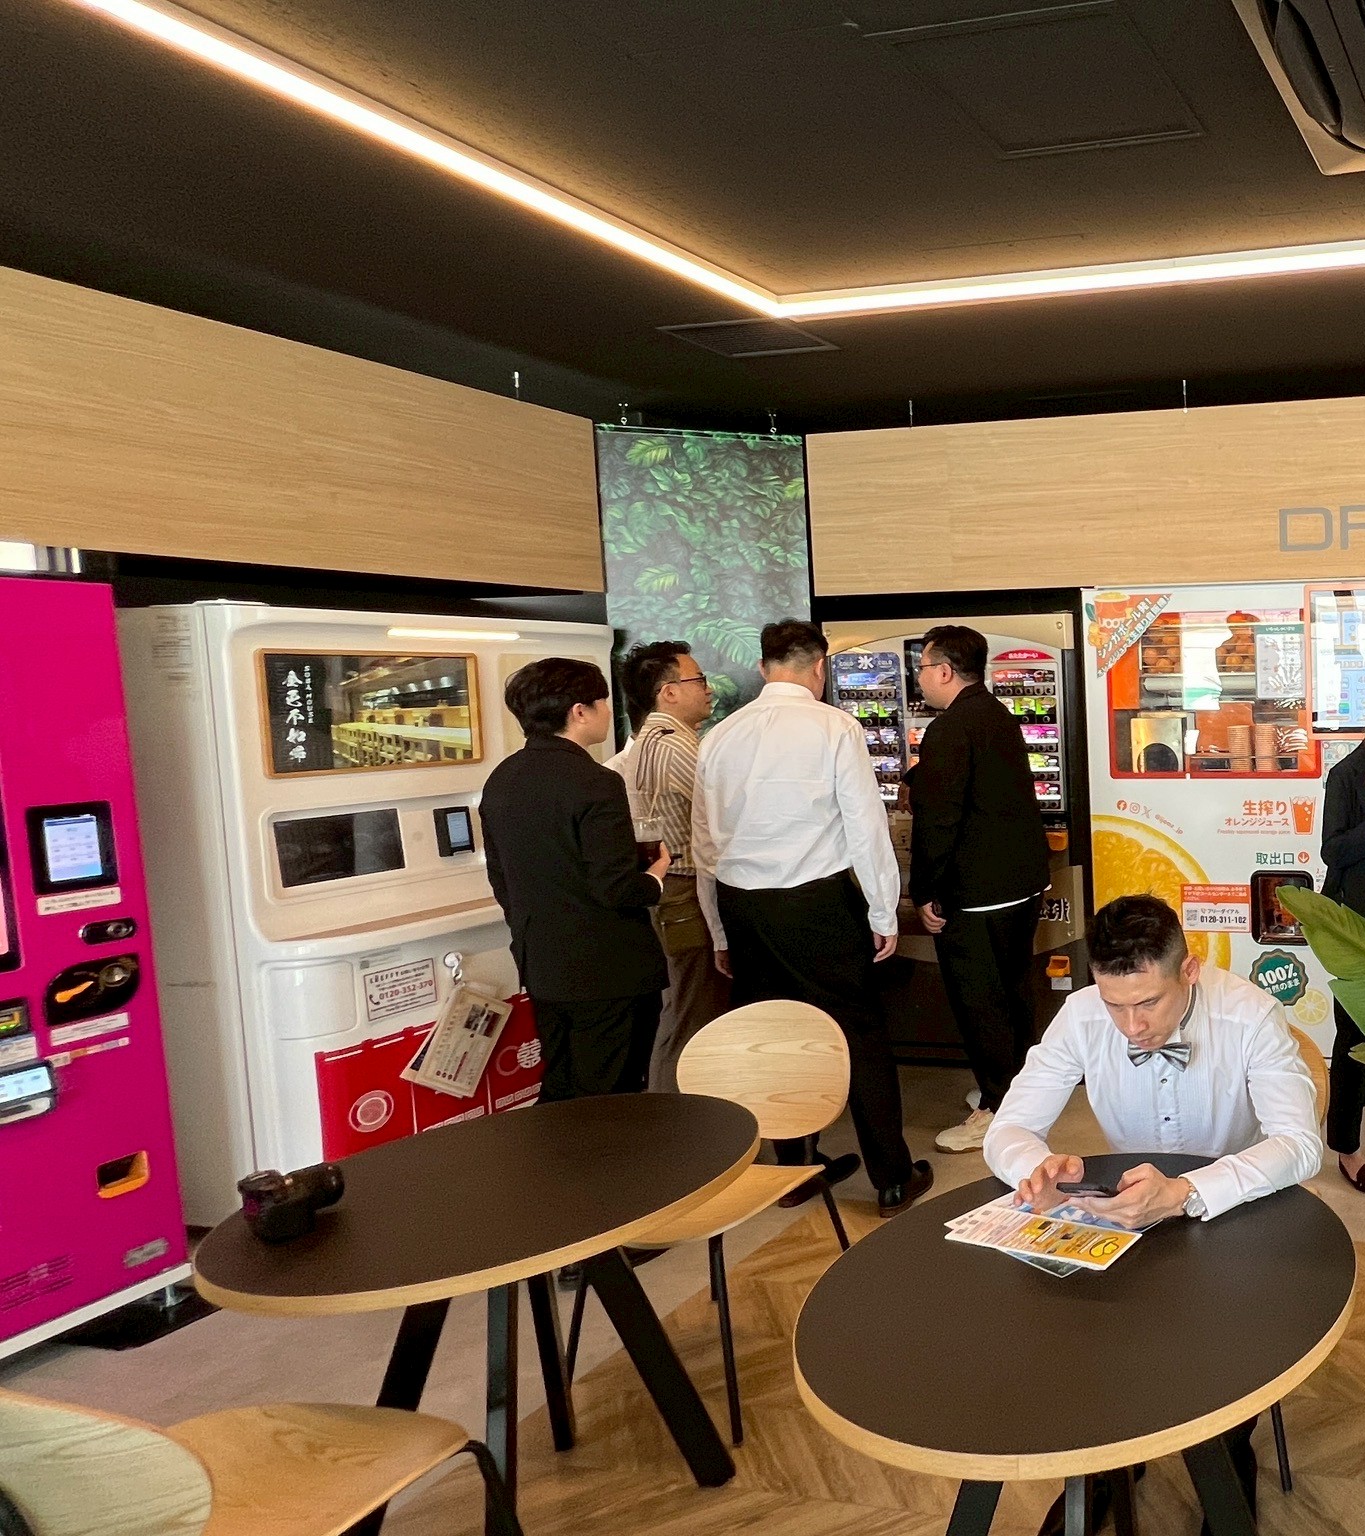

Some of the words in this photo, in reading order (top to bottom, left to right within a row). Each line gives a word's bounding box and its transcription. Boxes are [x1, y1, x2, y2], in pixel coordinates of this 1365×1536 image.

[304, 665, 312, 690] SOBA
[1242, 800, 1288, 816] 生搾り
[1224, 817, 1289, 827] オレンジジュース
[1255, 852, 1295, 865] 取出口
[1200, 915, 1247, 923] 0120-311-102
[1258, 963, 1298, 987] 100%
